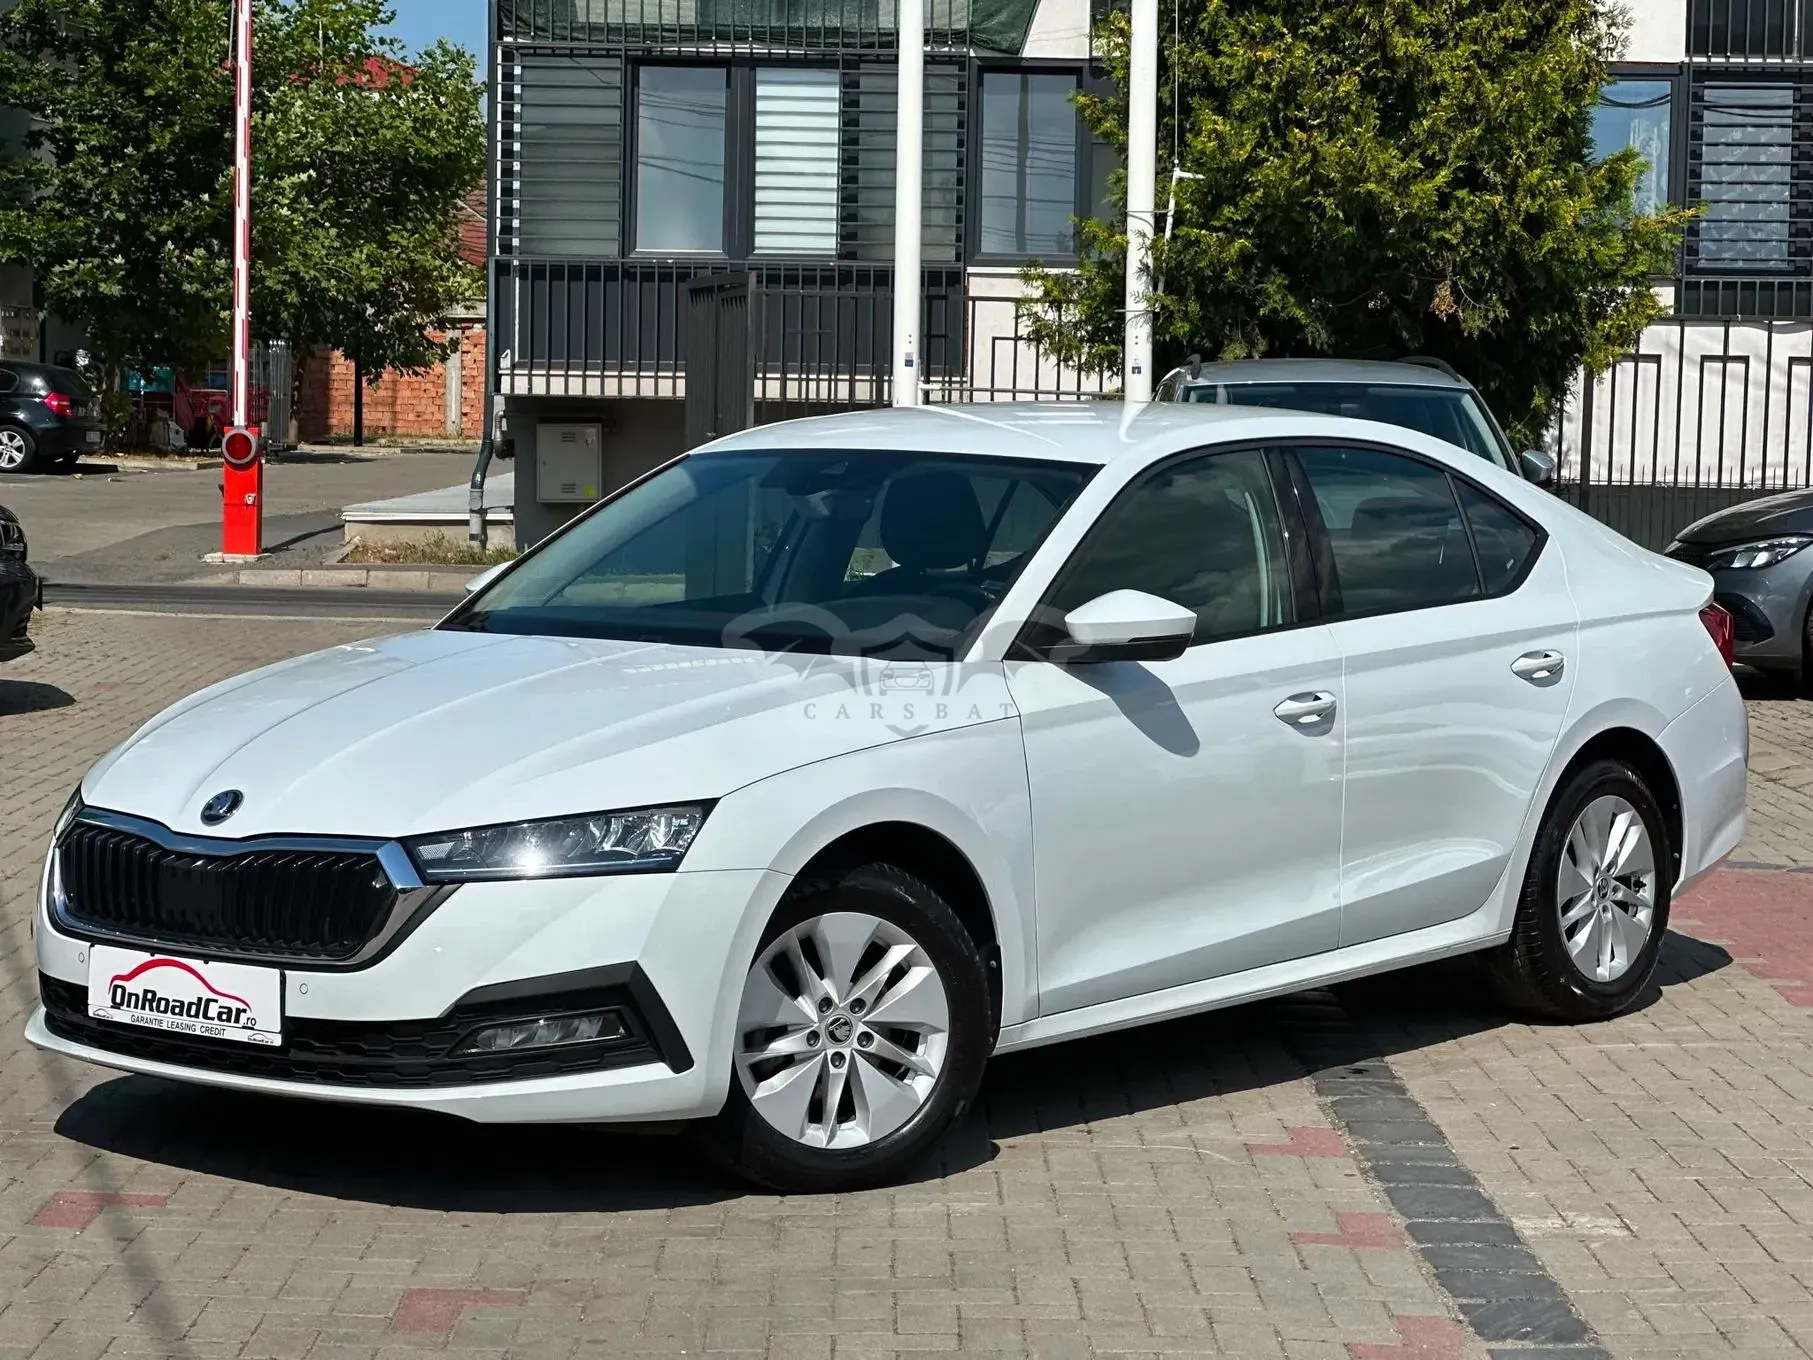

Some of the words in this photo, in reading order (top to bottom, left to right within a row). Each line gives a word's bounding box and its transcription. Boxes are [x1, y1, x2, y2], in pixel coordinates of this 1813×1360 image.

[130, 1014, 164, 1028] GARANTIE
[166, 1020, 197, 1033] LEASING
[199, 1025, 227, 1037] CREDIT
